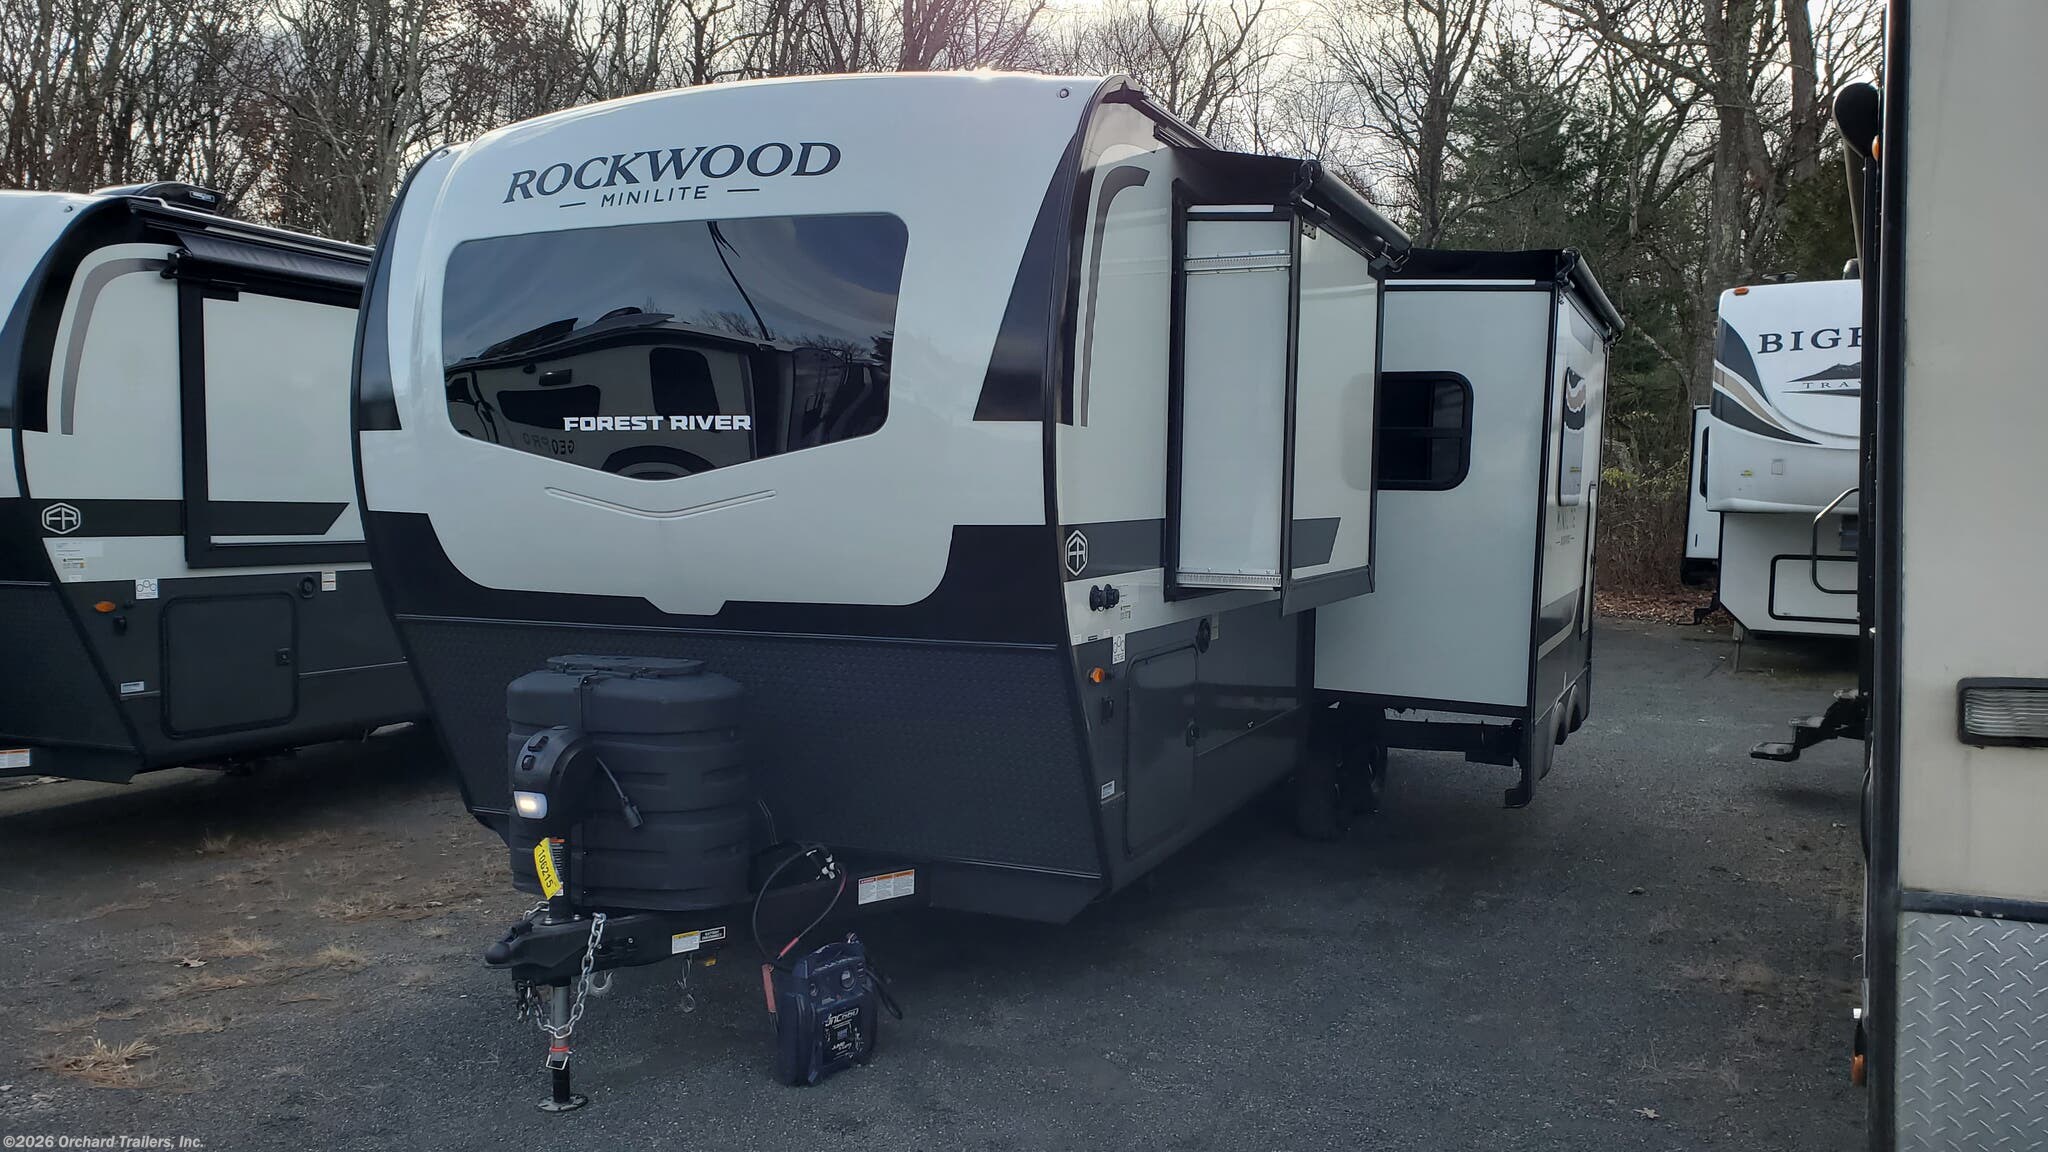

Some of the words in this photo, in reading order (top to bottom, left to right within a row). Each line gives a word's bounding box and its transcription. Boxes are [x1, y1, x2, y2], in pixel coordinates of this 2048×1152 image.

[502, 142, 842, 204] ROCKWOOD
[601, 185, 709, 208] MINILITE
[1803, 381, 1861, 389] TRA
[563, 416, 663, 431] FOREST
[669, 415, 751, 431] RIVER
[538, 849, 553, 888] 106215
